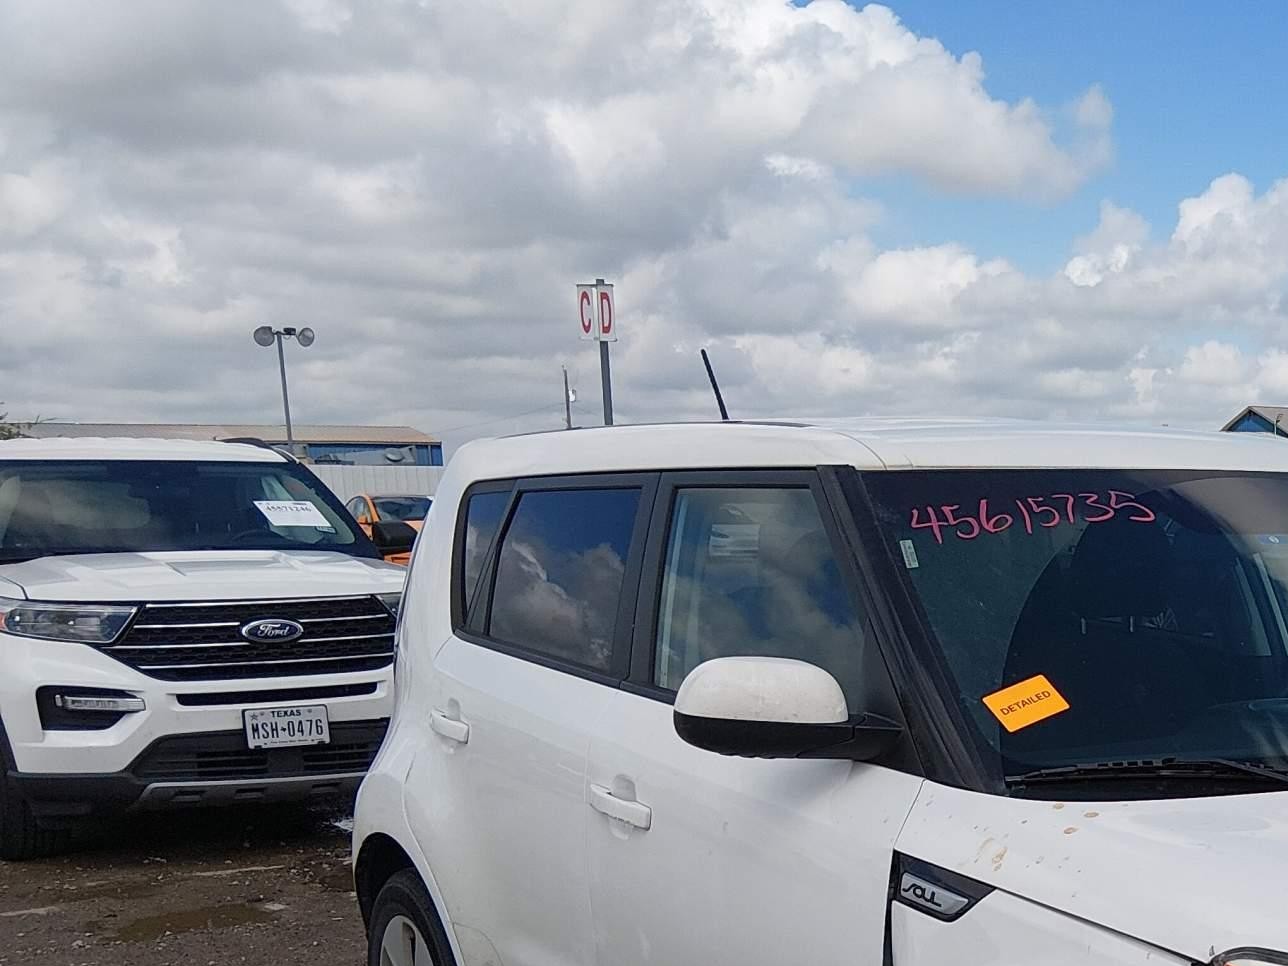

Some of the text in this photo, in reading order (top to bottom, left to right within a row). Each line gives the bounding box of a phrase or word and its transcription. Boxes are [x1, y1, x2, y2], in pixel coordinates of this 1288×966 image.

[580, 290, 612, 334] C D
[911, 490, 1156, 544] 45615735
[257, 623, 290, 637] Ford
[271, 709, 302, 718] TEXAS
[1000, 690, 1051, 716] DETAILED
